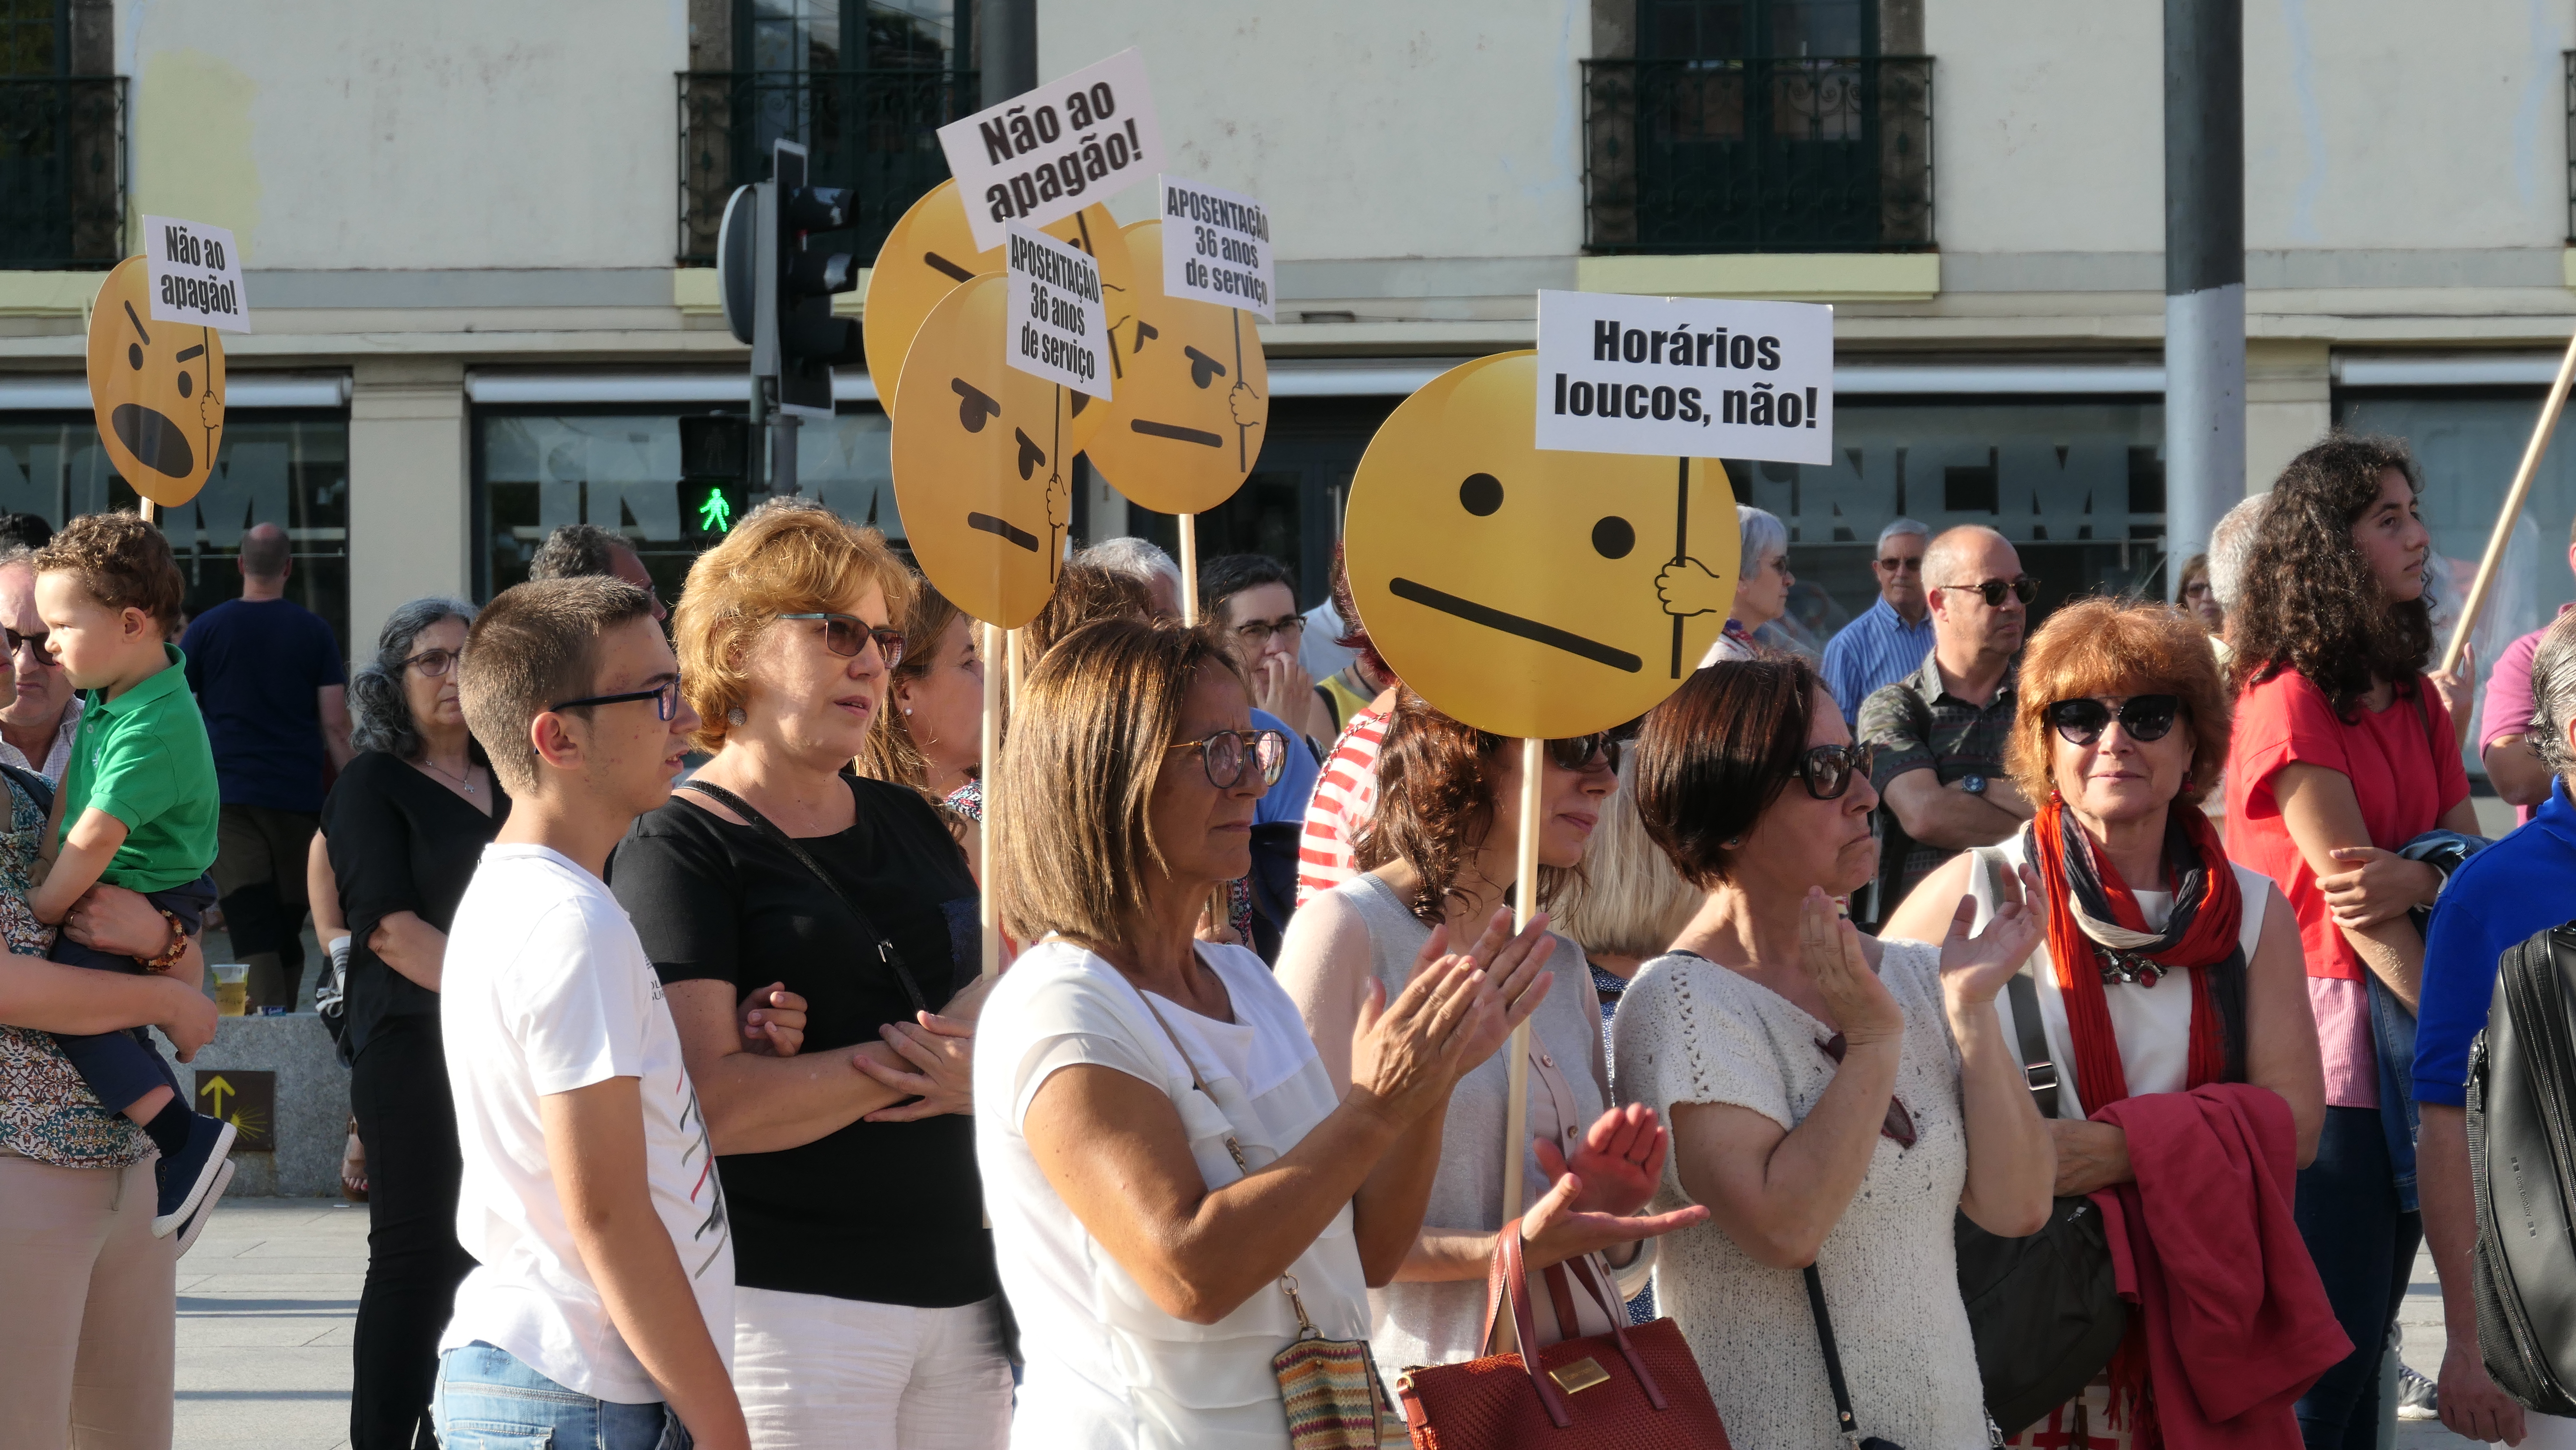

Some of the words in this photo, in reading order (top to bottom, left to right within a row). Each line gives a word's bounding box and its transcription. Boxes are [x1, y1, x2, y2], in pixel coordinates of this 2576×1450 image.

[978, 105, 1061, 166] Não
[1065, 81, 1116, 131] ao
[985, 117, 1143, 224] apagão!
[1167, 186, 1270, 244] APOSENTAÇÃO
[164, 225, 201, 267] Não
[203, 238, 226, 272] ao
[1011, 233, 1100, 305] APOSENTAÇÃO
[1194, 225, 1218, 258] 36
[1221, 236, 1259, 270] anos
[160, 274, 239, 316] apagão!
[1030, 281, 1049, 323] 36
[1051, 296, 1086, 337] anos
[1185, 257, 1209, 290] de
[1211, 266, 1268, 308] serviço
[1021, 320, 1039, 360] de
[1041, 333, 1095, 384] serviço
[1593, 319, 1781, 371] Horários
[1554, 372, 1711, 428] loucos,
[1722, 381, 1818, 429] não!
[2520, 1191, 2532, 1217] ANTONIO
